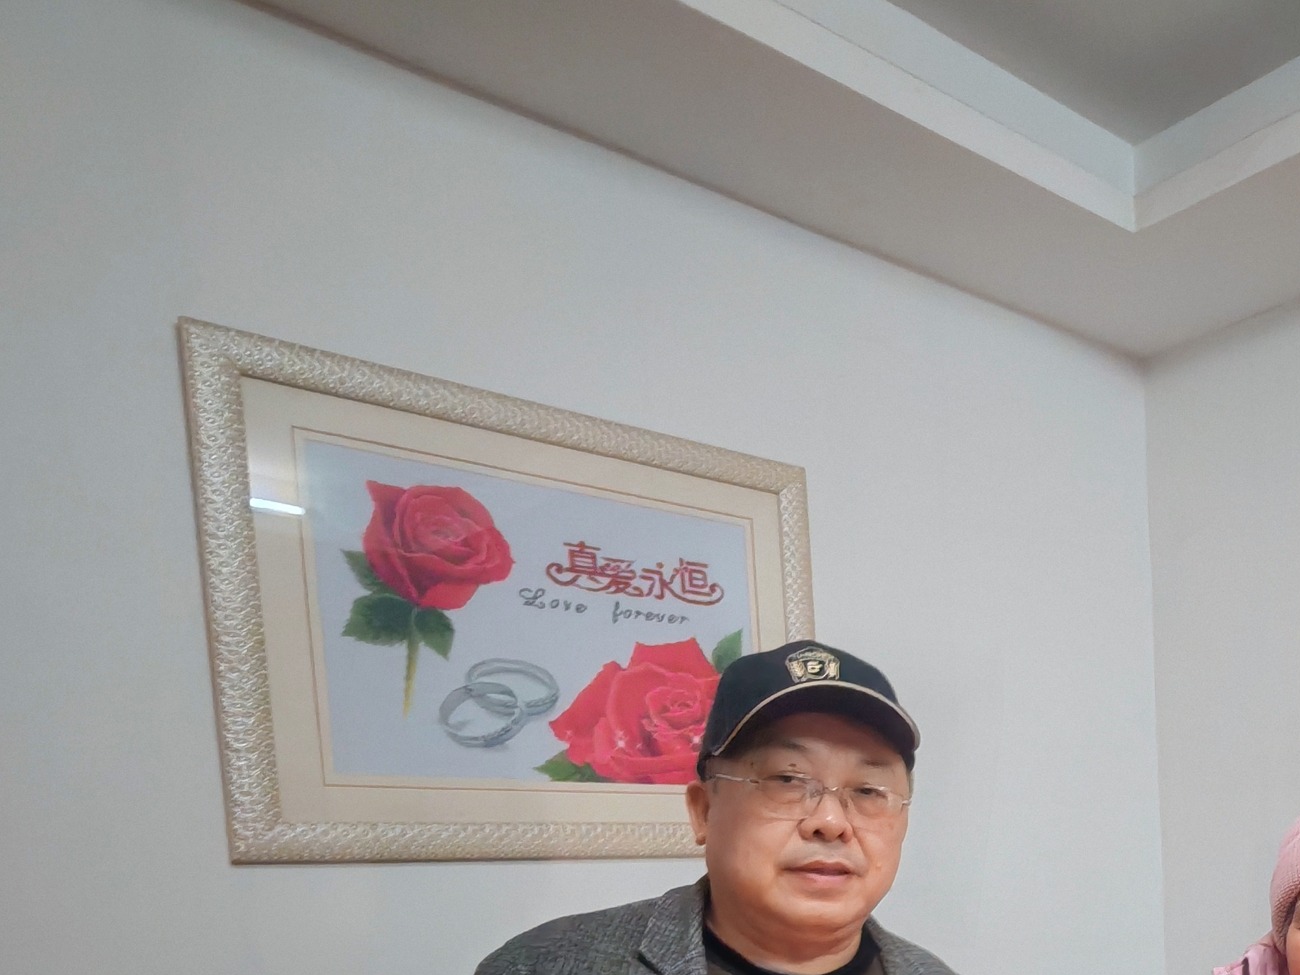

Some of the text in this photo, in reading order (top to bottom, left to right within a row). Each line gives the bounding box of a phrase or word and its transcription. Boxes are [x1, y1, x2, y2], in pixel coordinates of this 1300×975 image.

[546, 541, 725, 606] 真爱永恒
[519, 588, 690, 625] Love forever
